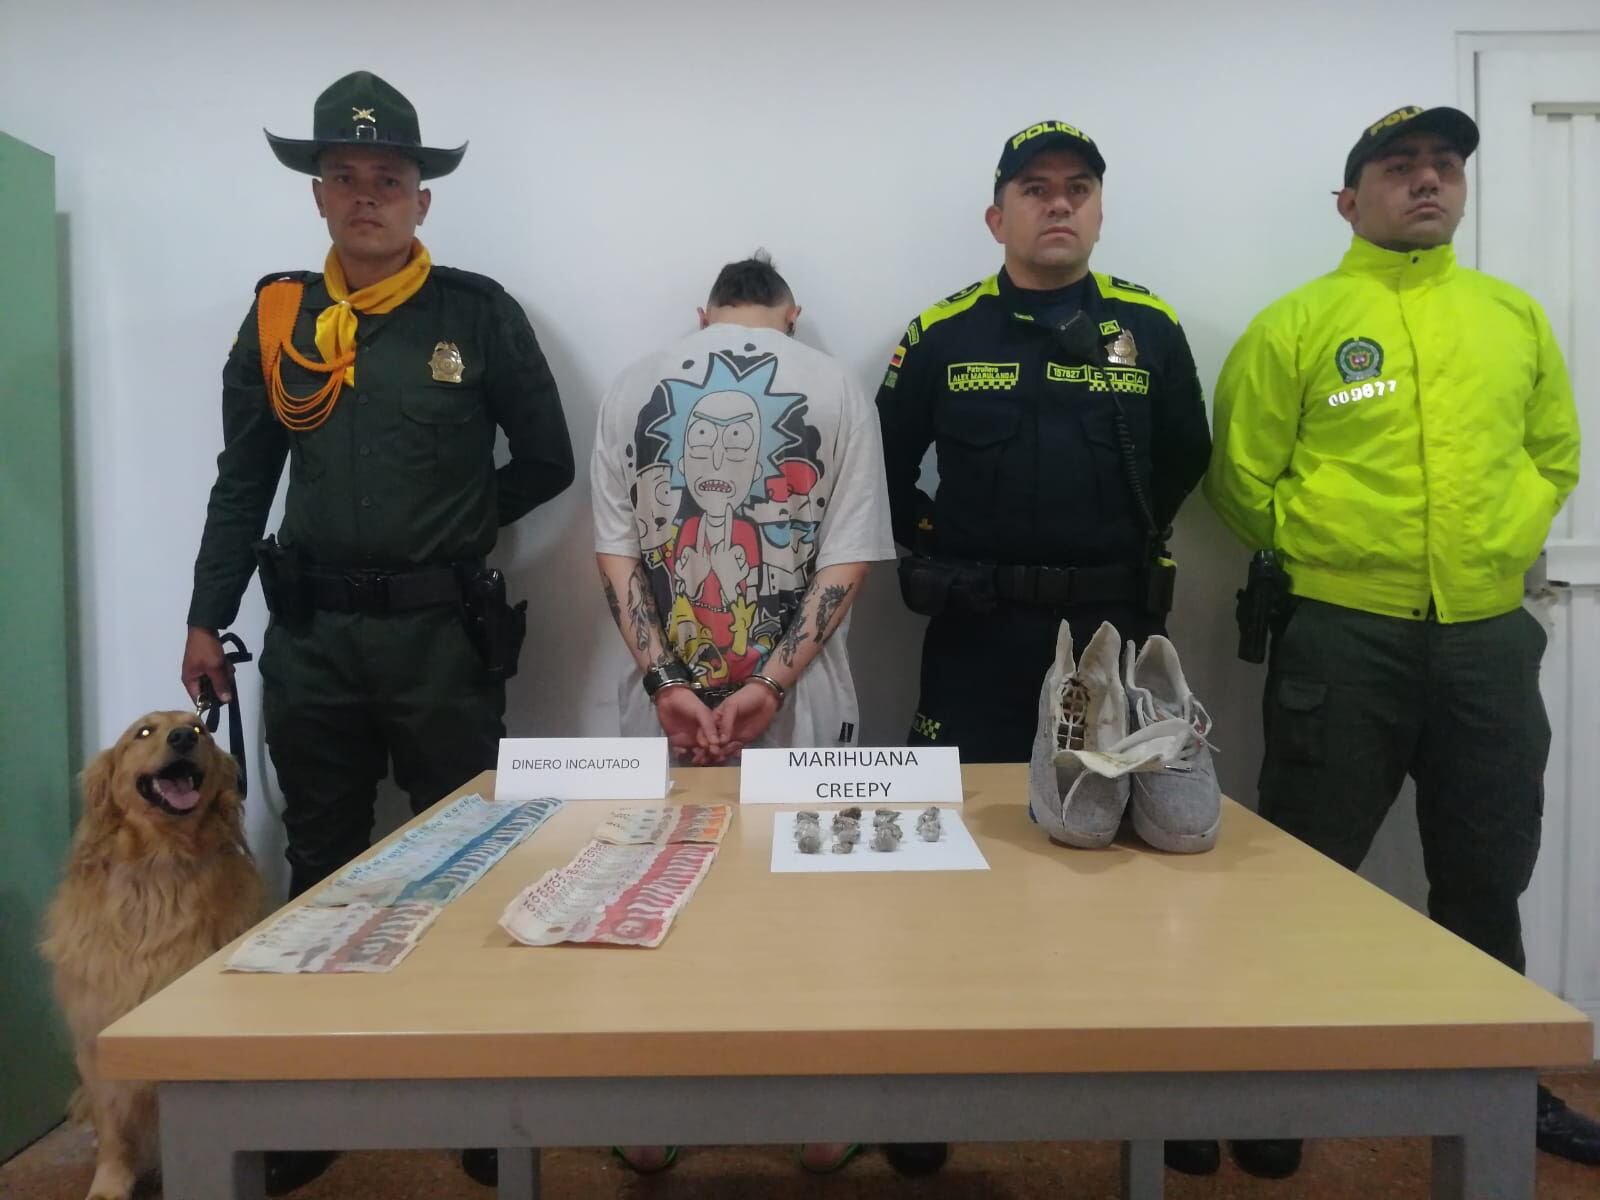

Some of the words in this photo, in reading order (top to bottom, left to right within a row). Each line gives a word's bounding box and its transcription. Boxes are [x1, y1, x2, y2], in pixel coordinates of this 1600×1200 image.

[1370, 107, 1424, 136] POLI
[512, 759, 561, 770] DINERO
[565, 758, 640, 769] INCAUTADO
[789, 751, 919, 767] MARIHUANA
[816, 782, 892, 798] CREEPY
